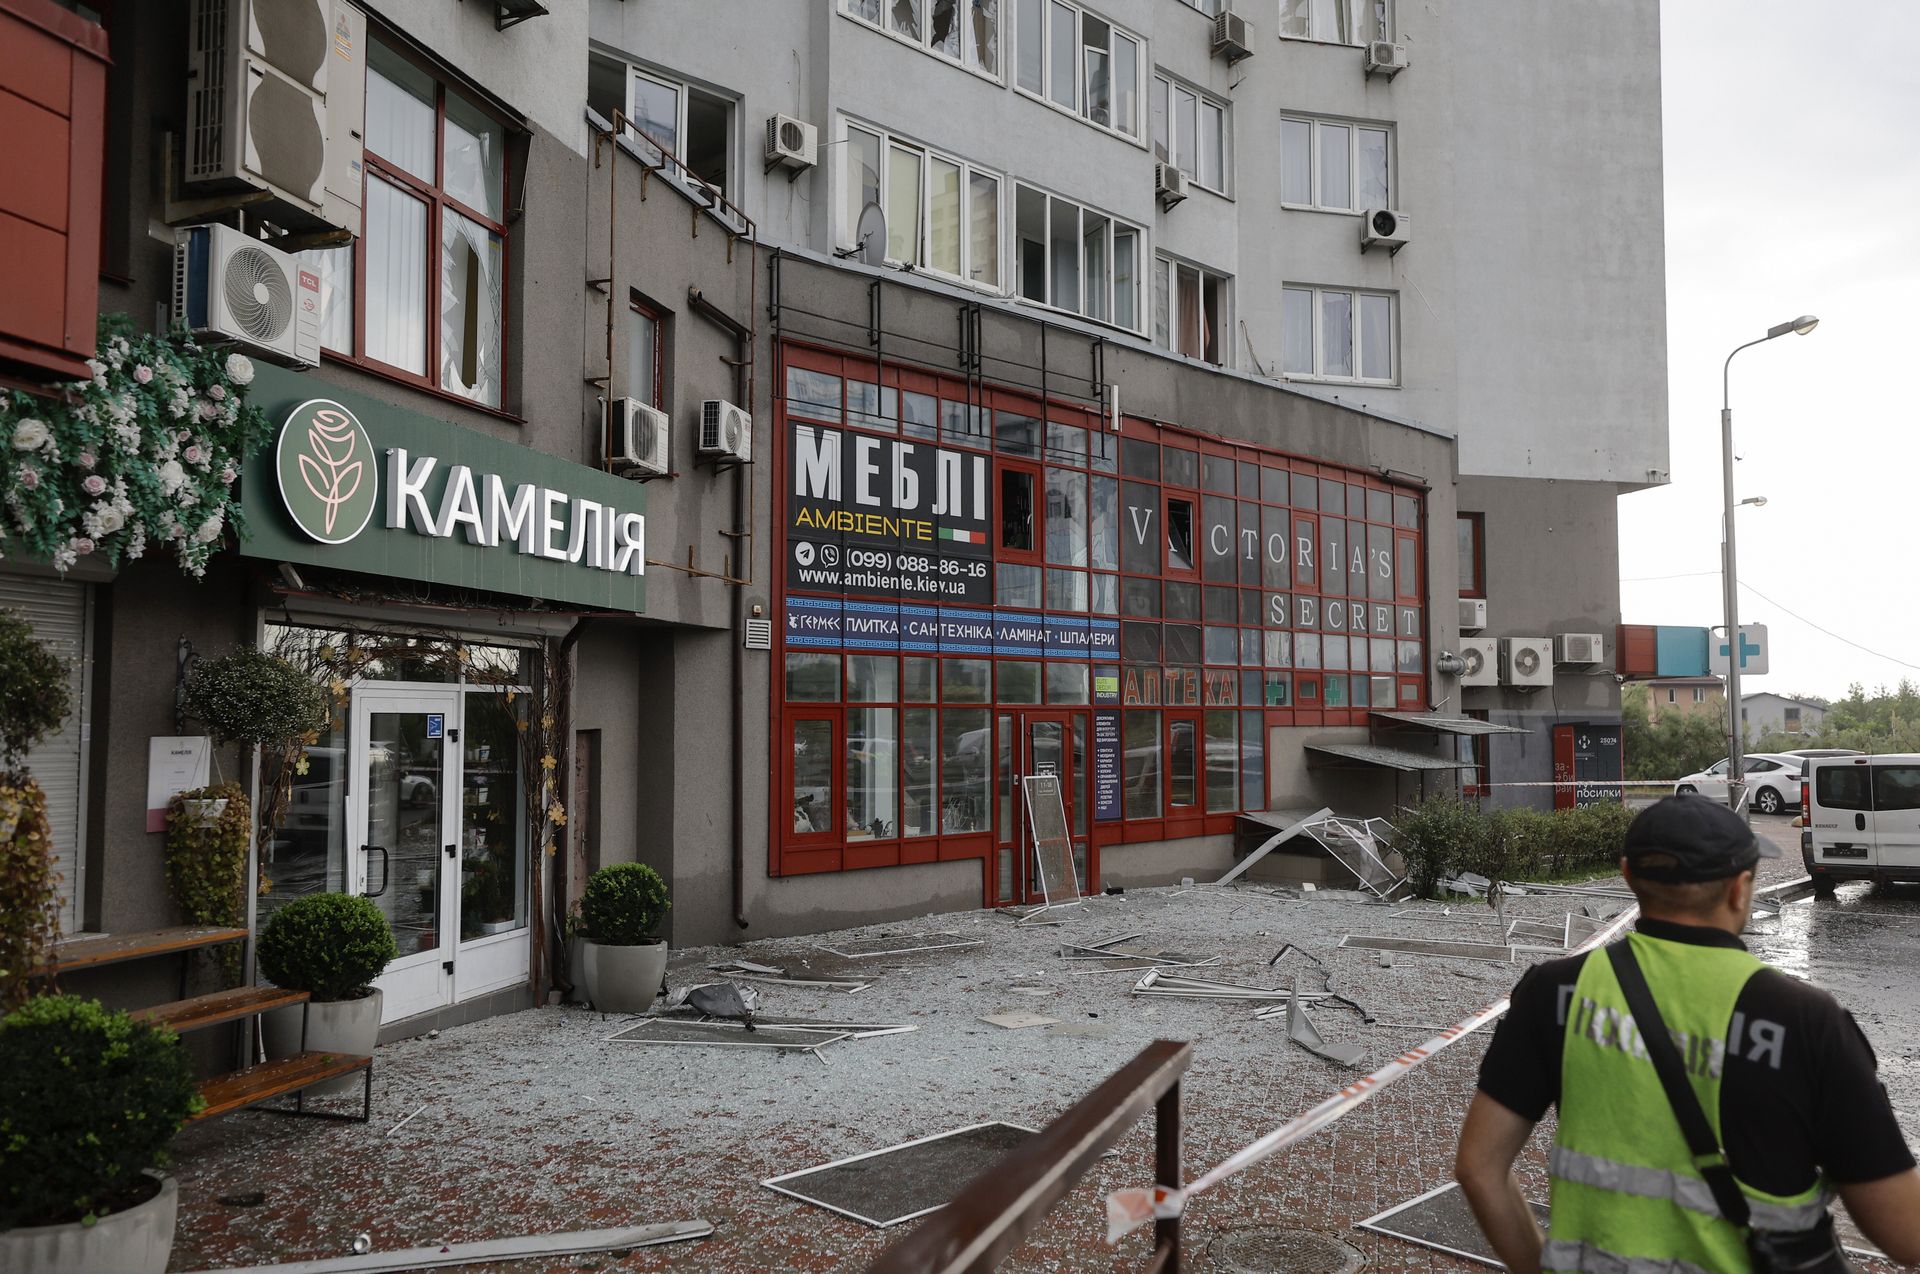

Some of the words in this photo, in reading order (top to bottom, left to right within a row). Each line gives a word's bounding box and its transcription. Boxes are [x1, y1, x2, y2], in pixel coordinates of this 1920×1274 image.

[795, 424, 986, 521] МЕБЛІ
[386, 447, 646, 577] КАМЕЛІЯ
[795, 507, 932, 541] AMBIENTE
[1128, 505, 1392, 579] VCTORIA'S
[846, 548, 892, 572] (099)
[896, 554, 987, 578] 088-86-16
[798, 568, 966, 595] www.ambiente.kiev.ua
[800, 614, 841, 631] ГЕРМЕС
[846, 617, 900, 634] ПЛИТКА
[909, 621, 993, 640] САНТЕХНІКА
[1000, 628, 1052, 643] ЛАМІНАТ
[1060, 631, 1115, 646] ШПАЛЕРИ
[1270, 594, 1415, 635] SECRET
[1124, 667, 1236, 706] АПТЕКА
[1576, 789, 1621, 798] посилки
